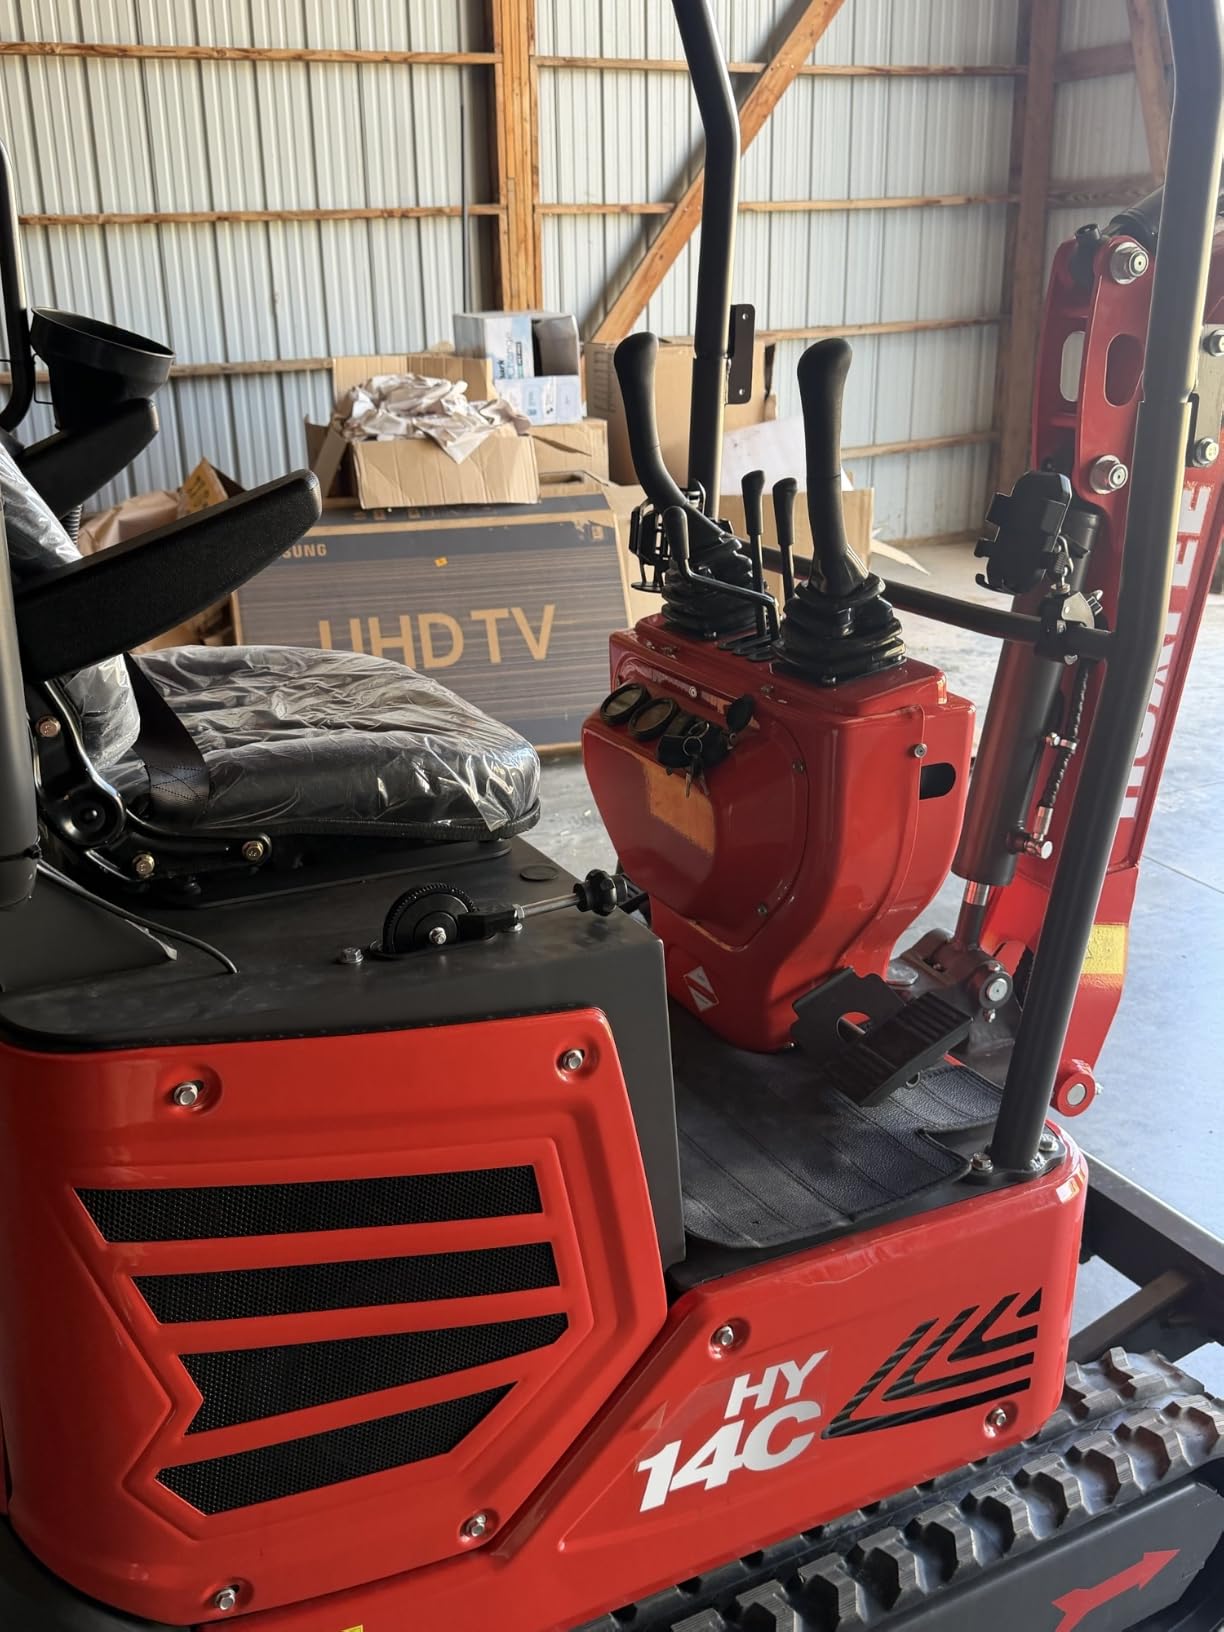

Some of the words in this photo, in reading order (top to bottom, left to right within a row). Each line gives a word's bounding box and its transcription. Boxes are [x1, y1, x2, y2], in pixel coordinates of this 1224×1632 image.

[282, 543, 328, 559] SUNG
[724, 1350, 829, 1420] HY
[637, 1400, 822, 1513] 14C
